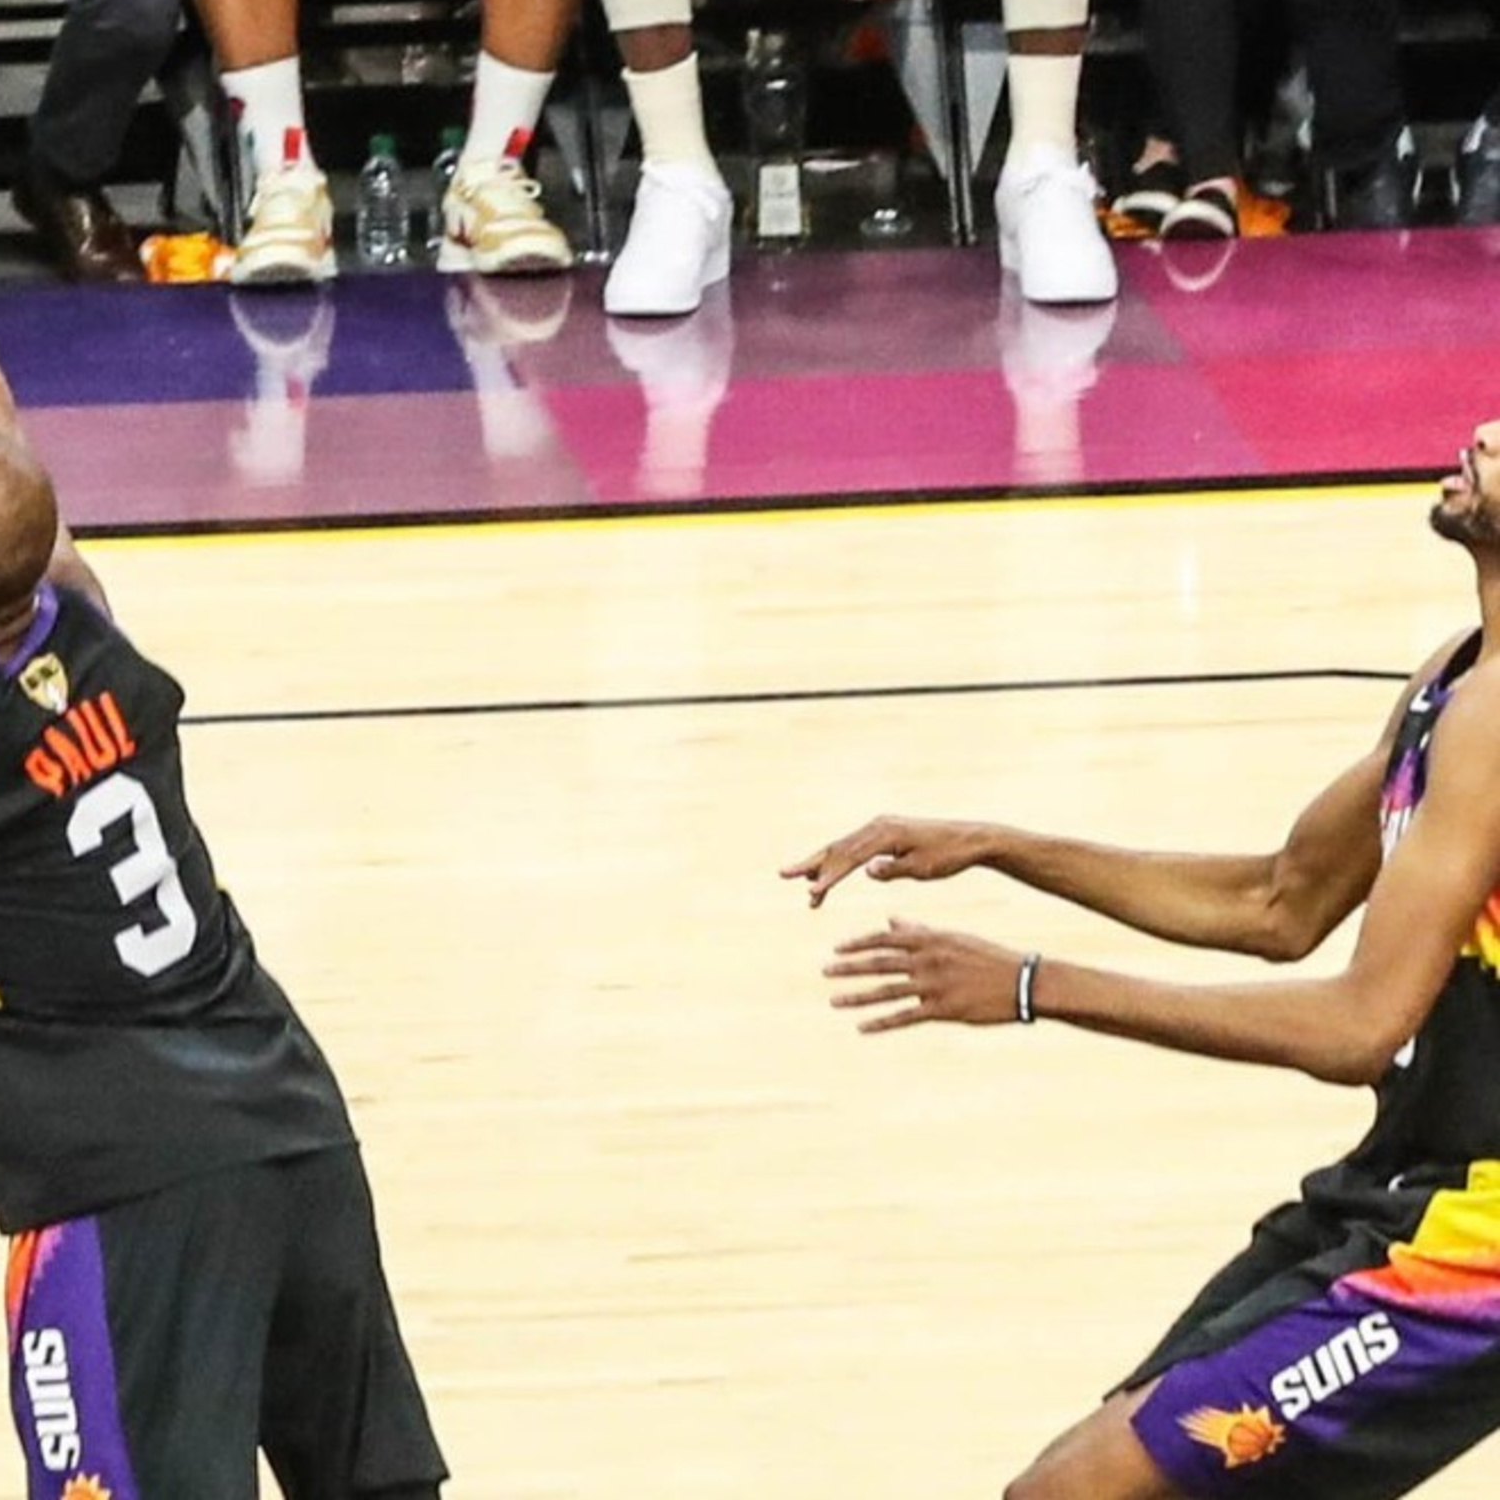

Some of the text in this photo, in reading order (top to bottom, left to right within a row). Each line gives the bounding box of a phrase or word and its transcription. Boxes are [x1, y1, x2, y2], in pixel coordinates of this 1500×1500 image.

[24, 690, 135, 798] PAUL
[66, 772, 197, 977] 3
[22, 1328, 80, 1471] SUNS
[1270, 1310, 1399, 1421] SUNS
